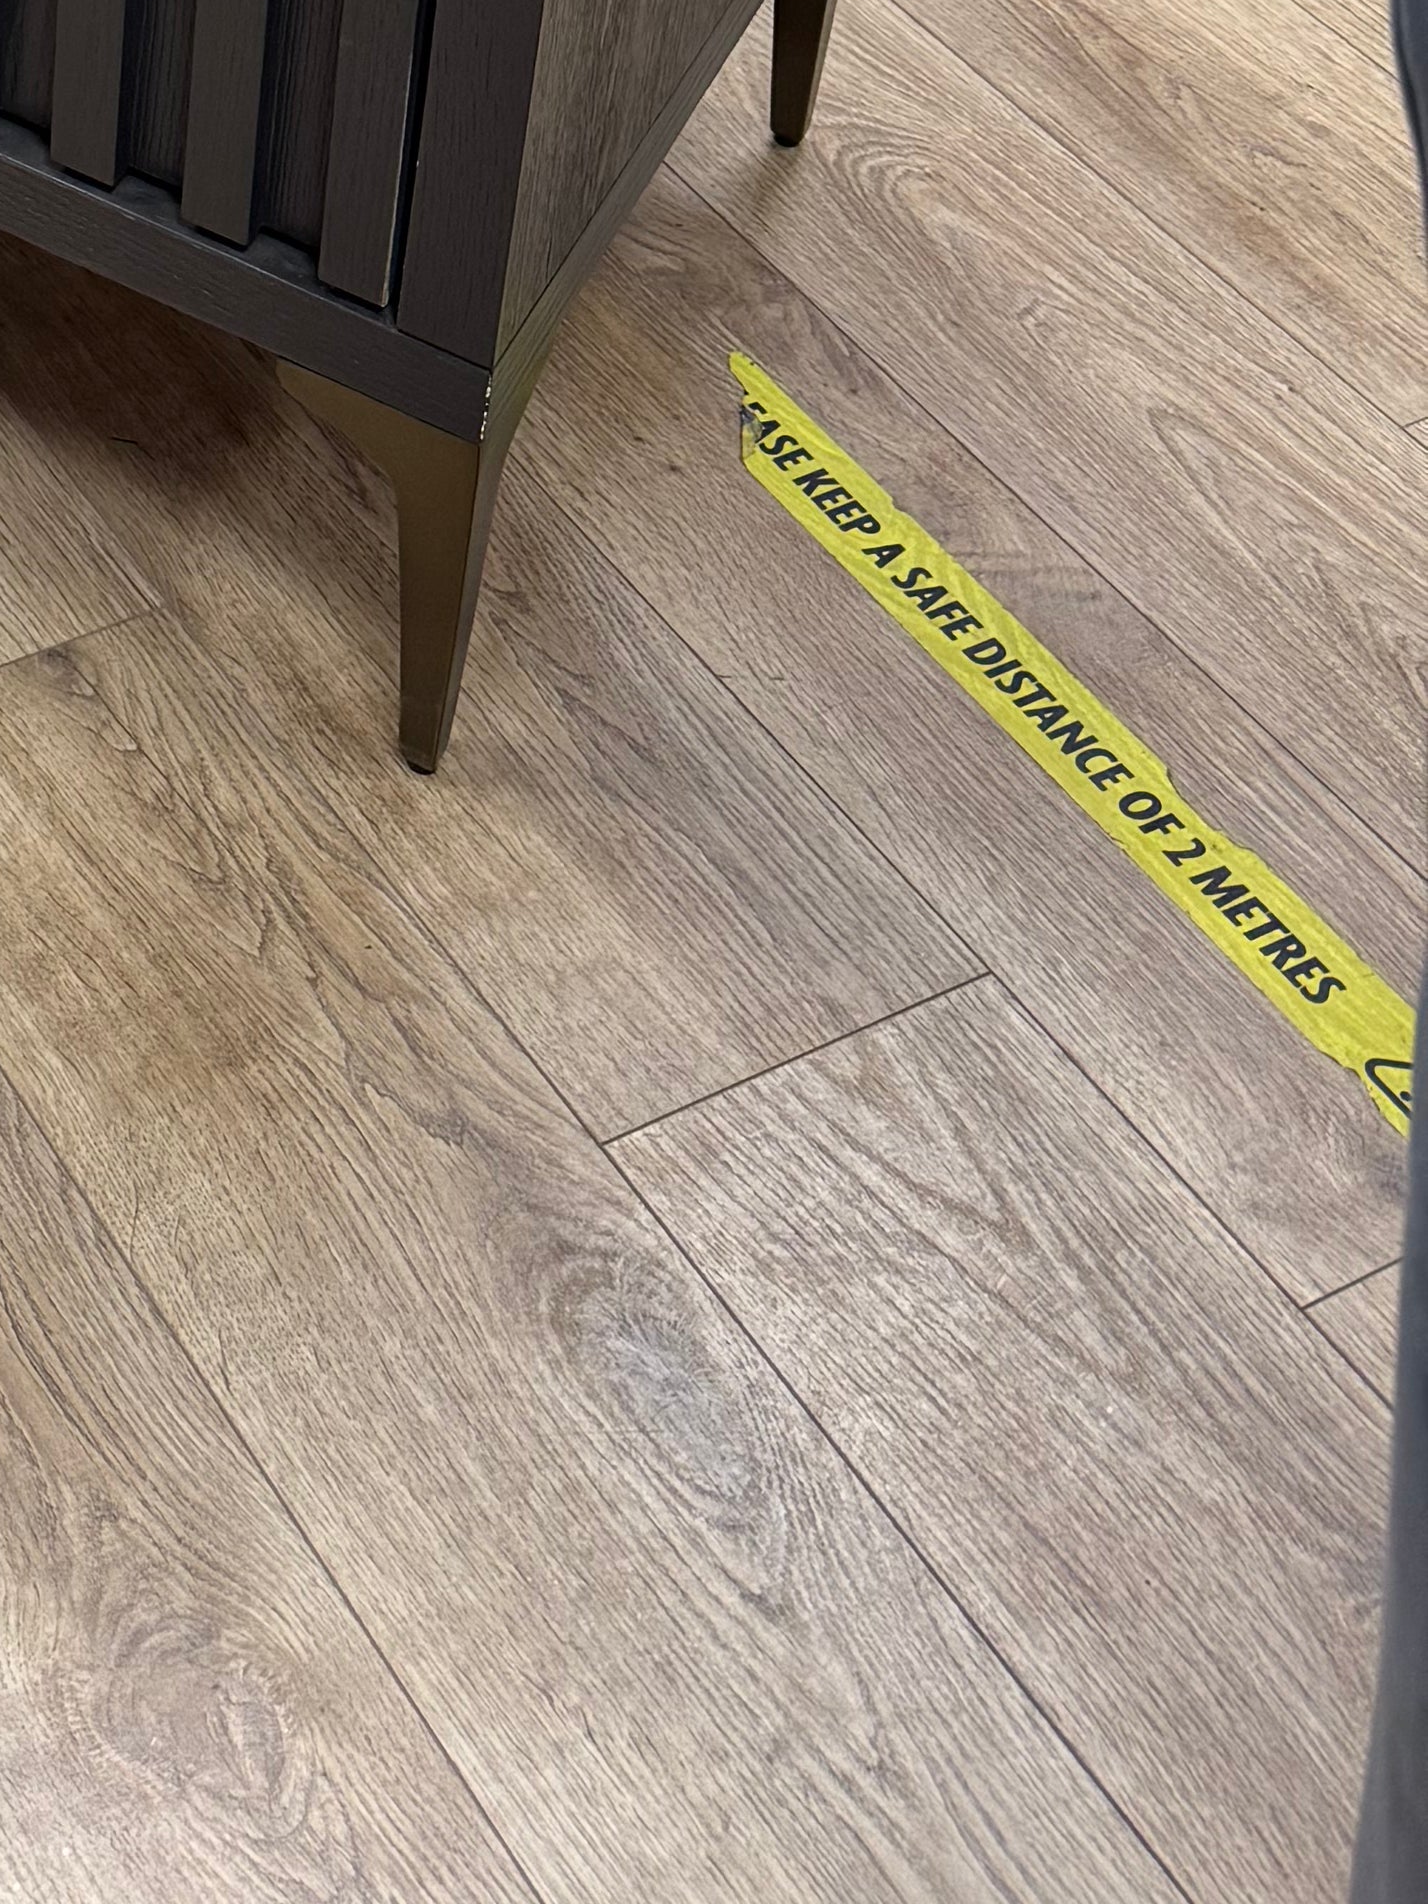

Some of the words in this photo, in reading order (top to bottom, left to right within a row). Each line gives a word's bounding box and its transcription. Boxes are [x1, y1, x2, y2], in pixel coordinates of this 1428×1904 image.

[792, 467, 882, 535] KEEP
[861, 543, 907, 570] A
[890, 566, 985, 642] SAFE
[960, 636, 1136, 792] DISTANCE
[1117, 790, 1187, 836] OF
[1162, 837, 1207, 868] 2
[1188, 864, 1348, 1005] METRES
